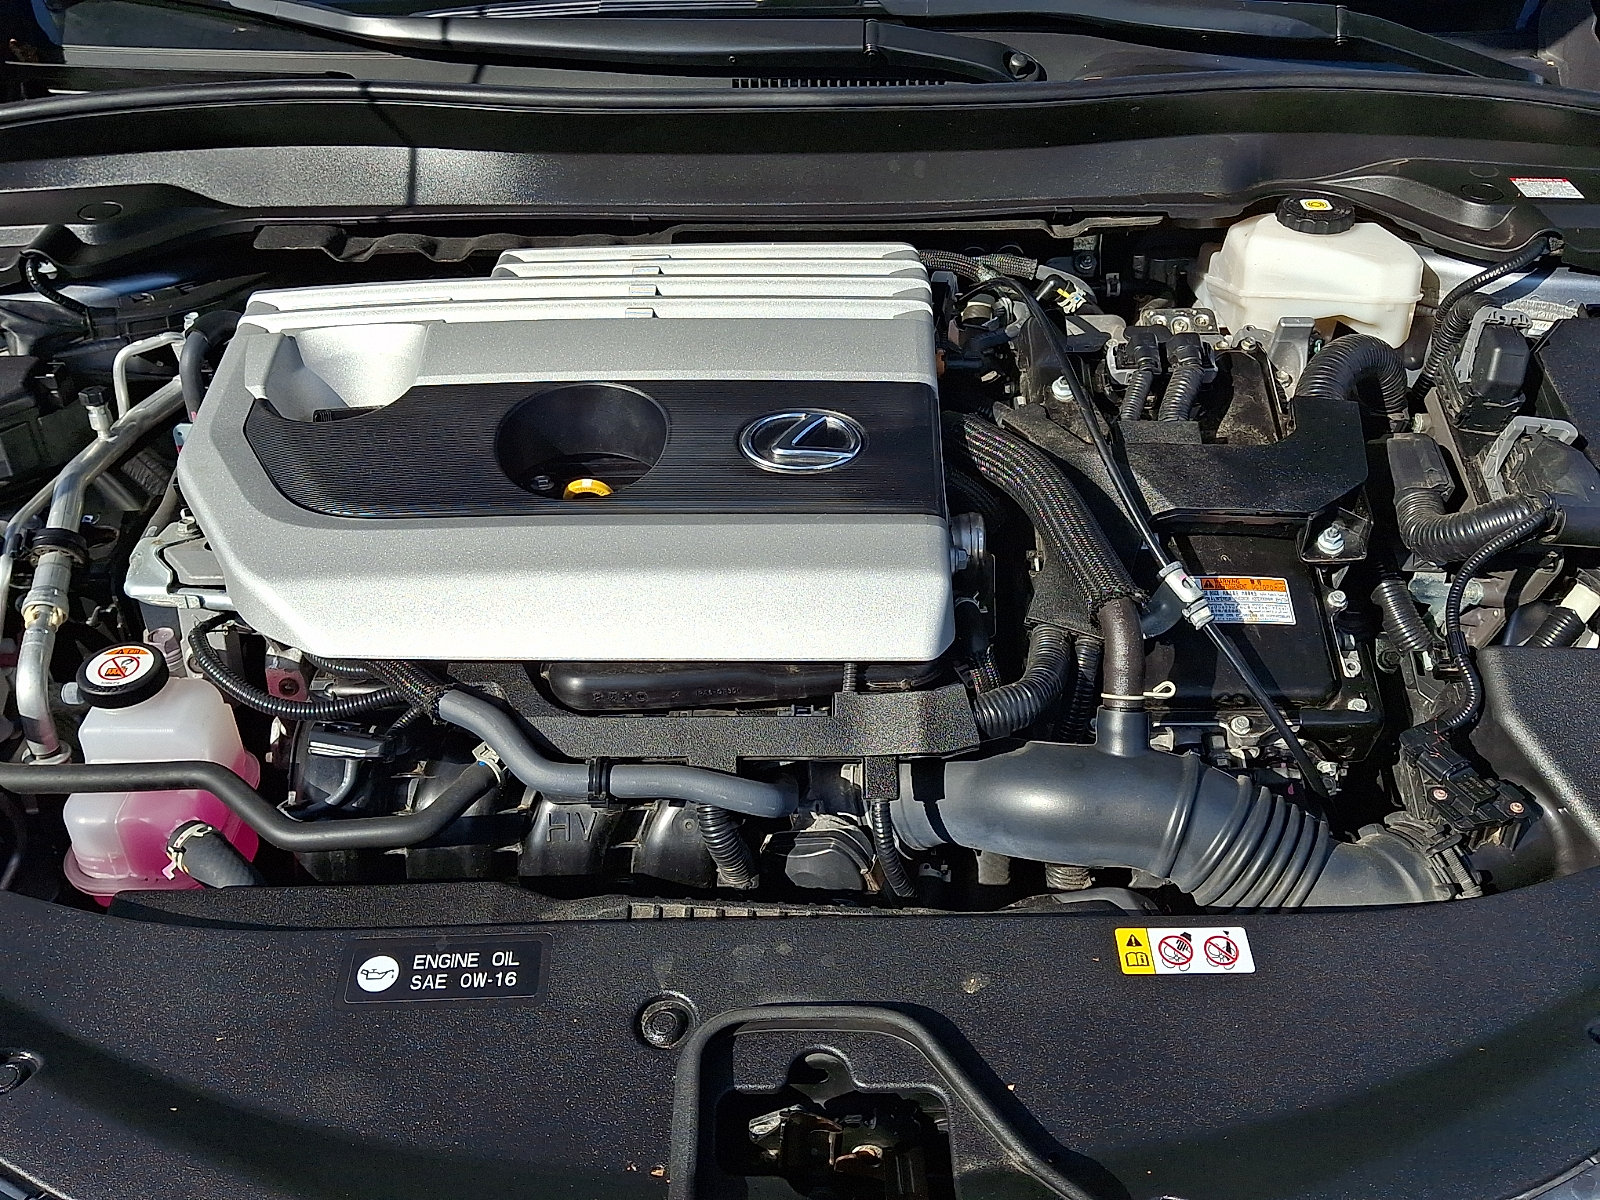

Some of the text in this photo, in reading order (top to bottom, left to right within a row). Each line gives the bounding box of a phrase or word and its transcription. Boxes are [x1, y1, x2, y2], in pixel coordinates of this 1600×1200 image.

[546, 811, 599, 842] HV
[413, 950, 520, 970] ENGINE OIL
[410, 971, 517, 990] SAE 0W-16
